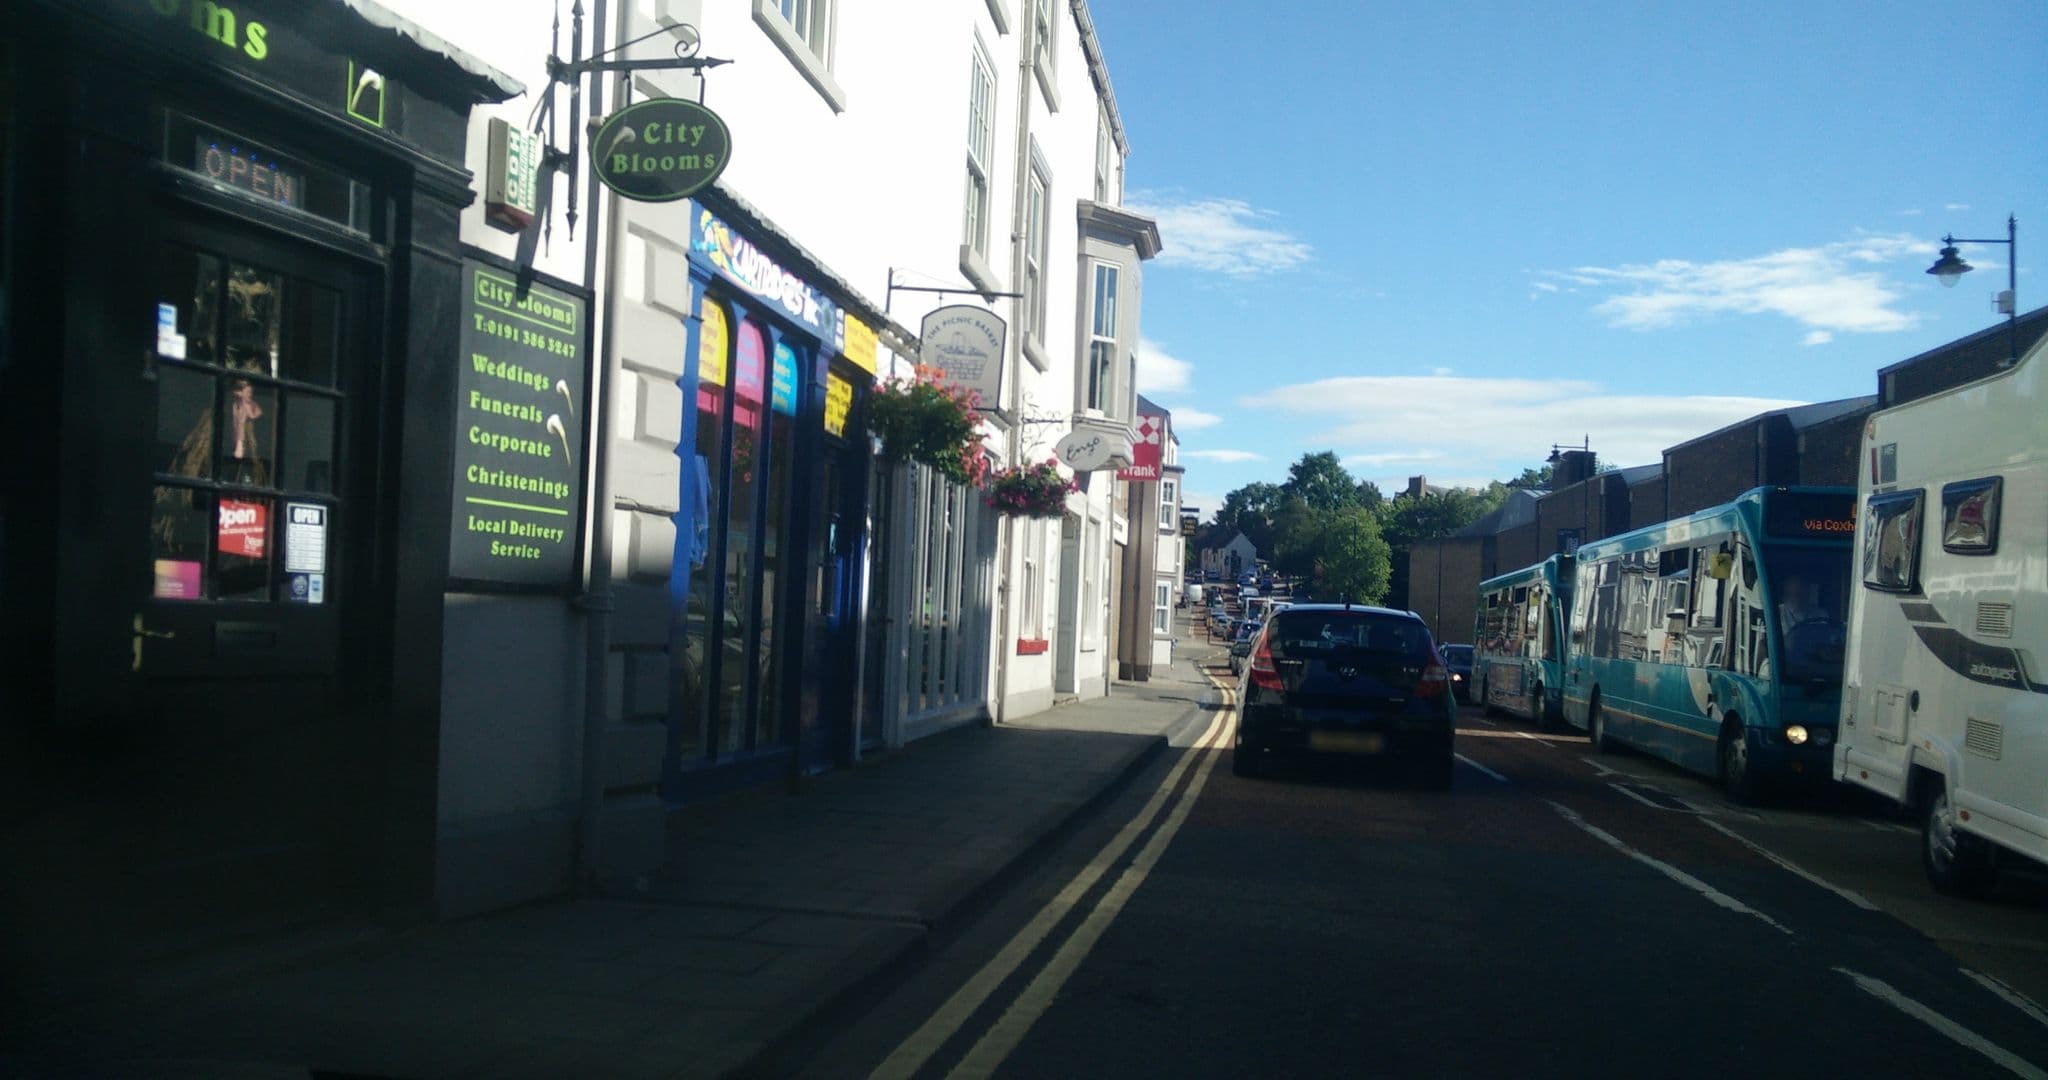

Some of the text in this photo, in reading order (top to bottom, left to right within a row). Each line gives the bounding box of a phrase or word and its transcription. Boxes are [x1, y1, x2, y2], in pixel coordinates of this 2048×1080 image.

[643, 122, 706, 147] City
[204, 148, 291, 202] OPEN
[612, 153, 716, 174] Blooms
[479, 279, 513, 307] City
[474, 313, 576, 358] T:0191 386 3247
[928, 317, 998, 347] THE PICNIC BASKET
[472, 353, 550, 391] Weddings
[469, 390, 543, 423] Funerals
[469, 426, 552, 458] Corporate
[467, 464, 569, 499] Christenings
[468, 515, 564, 543] Local Delivery
[491, 540, 541, 559] Service
